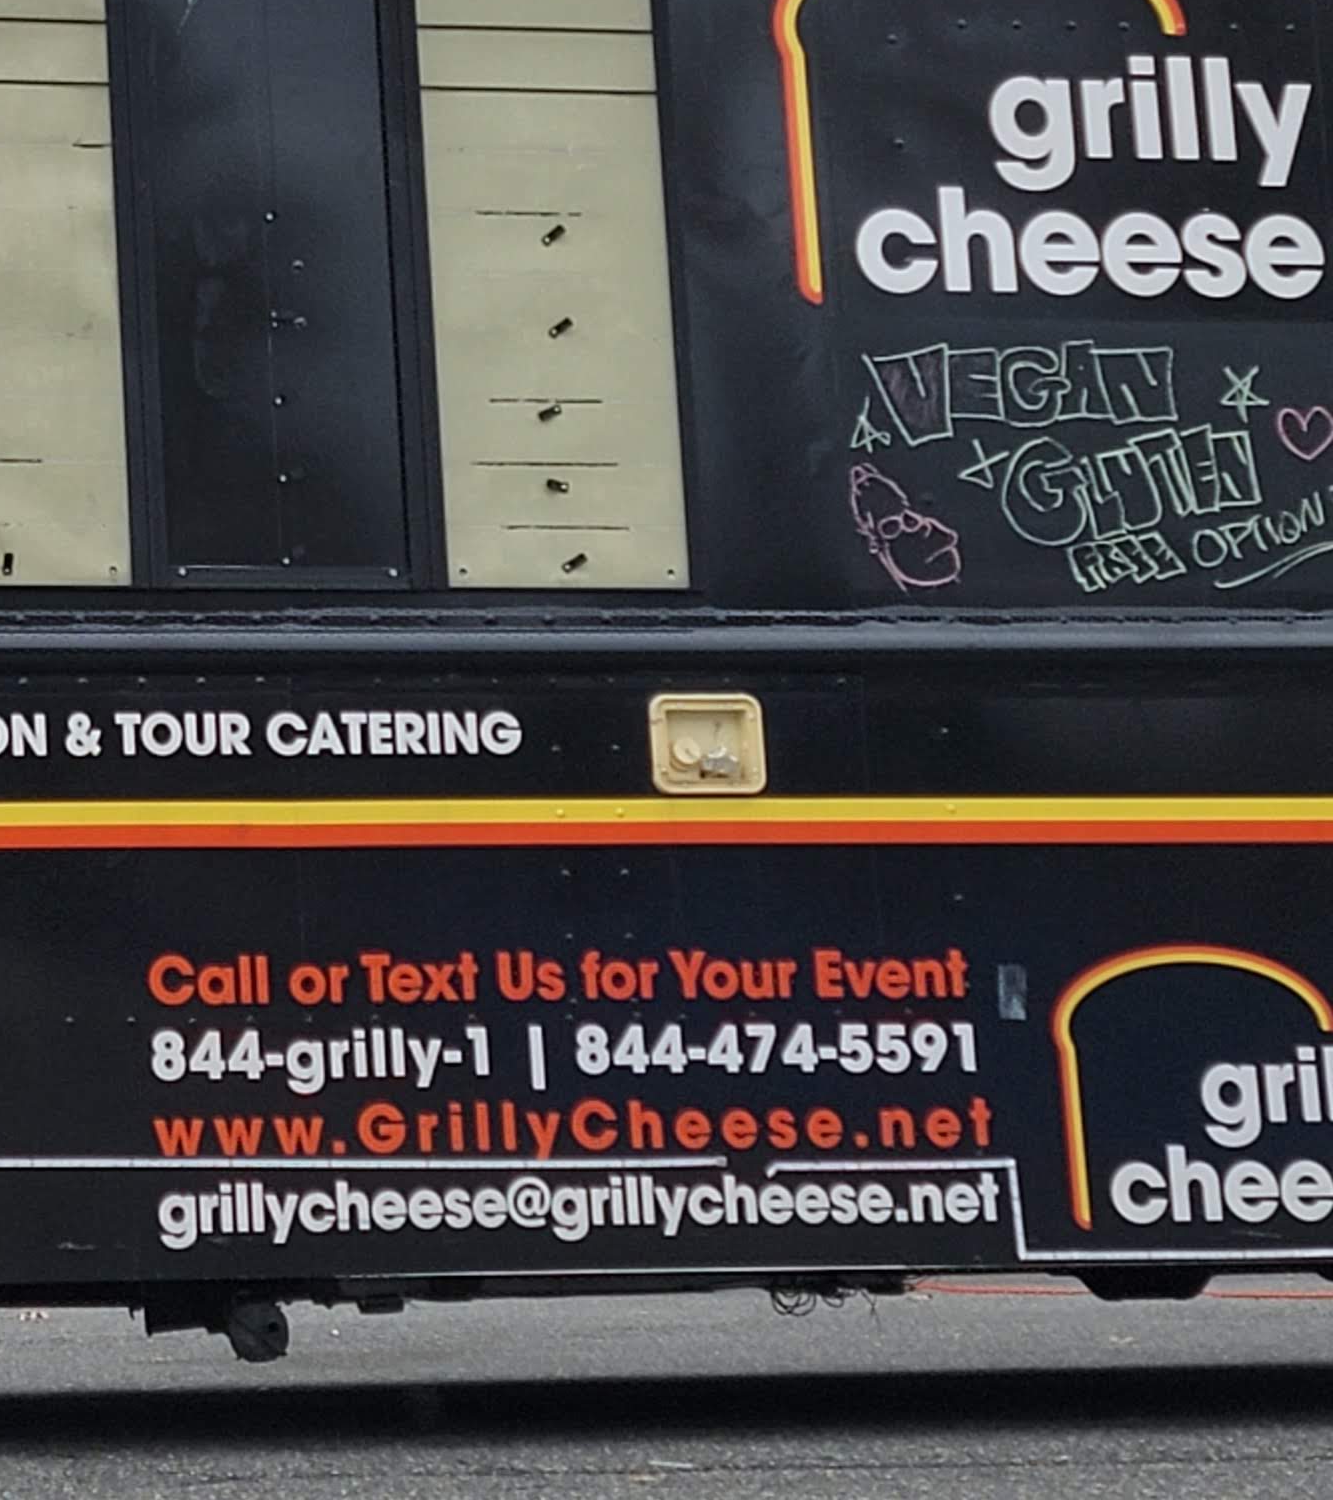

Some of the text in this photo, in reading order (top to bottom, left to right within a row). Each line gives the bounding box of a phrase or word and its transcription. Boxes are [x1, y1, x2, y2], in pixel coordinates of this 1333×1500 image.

[989, 55, 1312, 191] grilly
[855, 185, 1325, 299] cheese
[862, 340, 1179, 446] VEGAN
[1002, 423, 1262, 546] GLUTEN
[1066, 485, 1333, 592] FREE OPTION
[65, 712, 102, 757] &
[114, 711, 252, 756] TOUR
[266, 710, 522, 756] CATERING
[148, 949, 967, 1005] Call or Text Us for Your Event
[151, 1026, 490, 1095] 844-grilly-1
[576, 1022, 977, 1075] 844-474-5591
[153, 1097, 991, 1159] www.GrillyCheese.net
[158, 1173, 999, 1249] grillycheese@grillycheese.net
